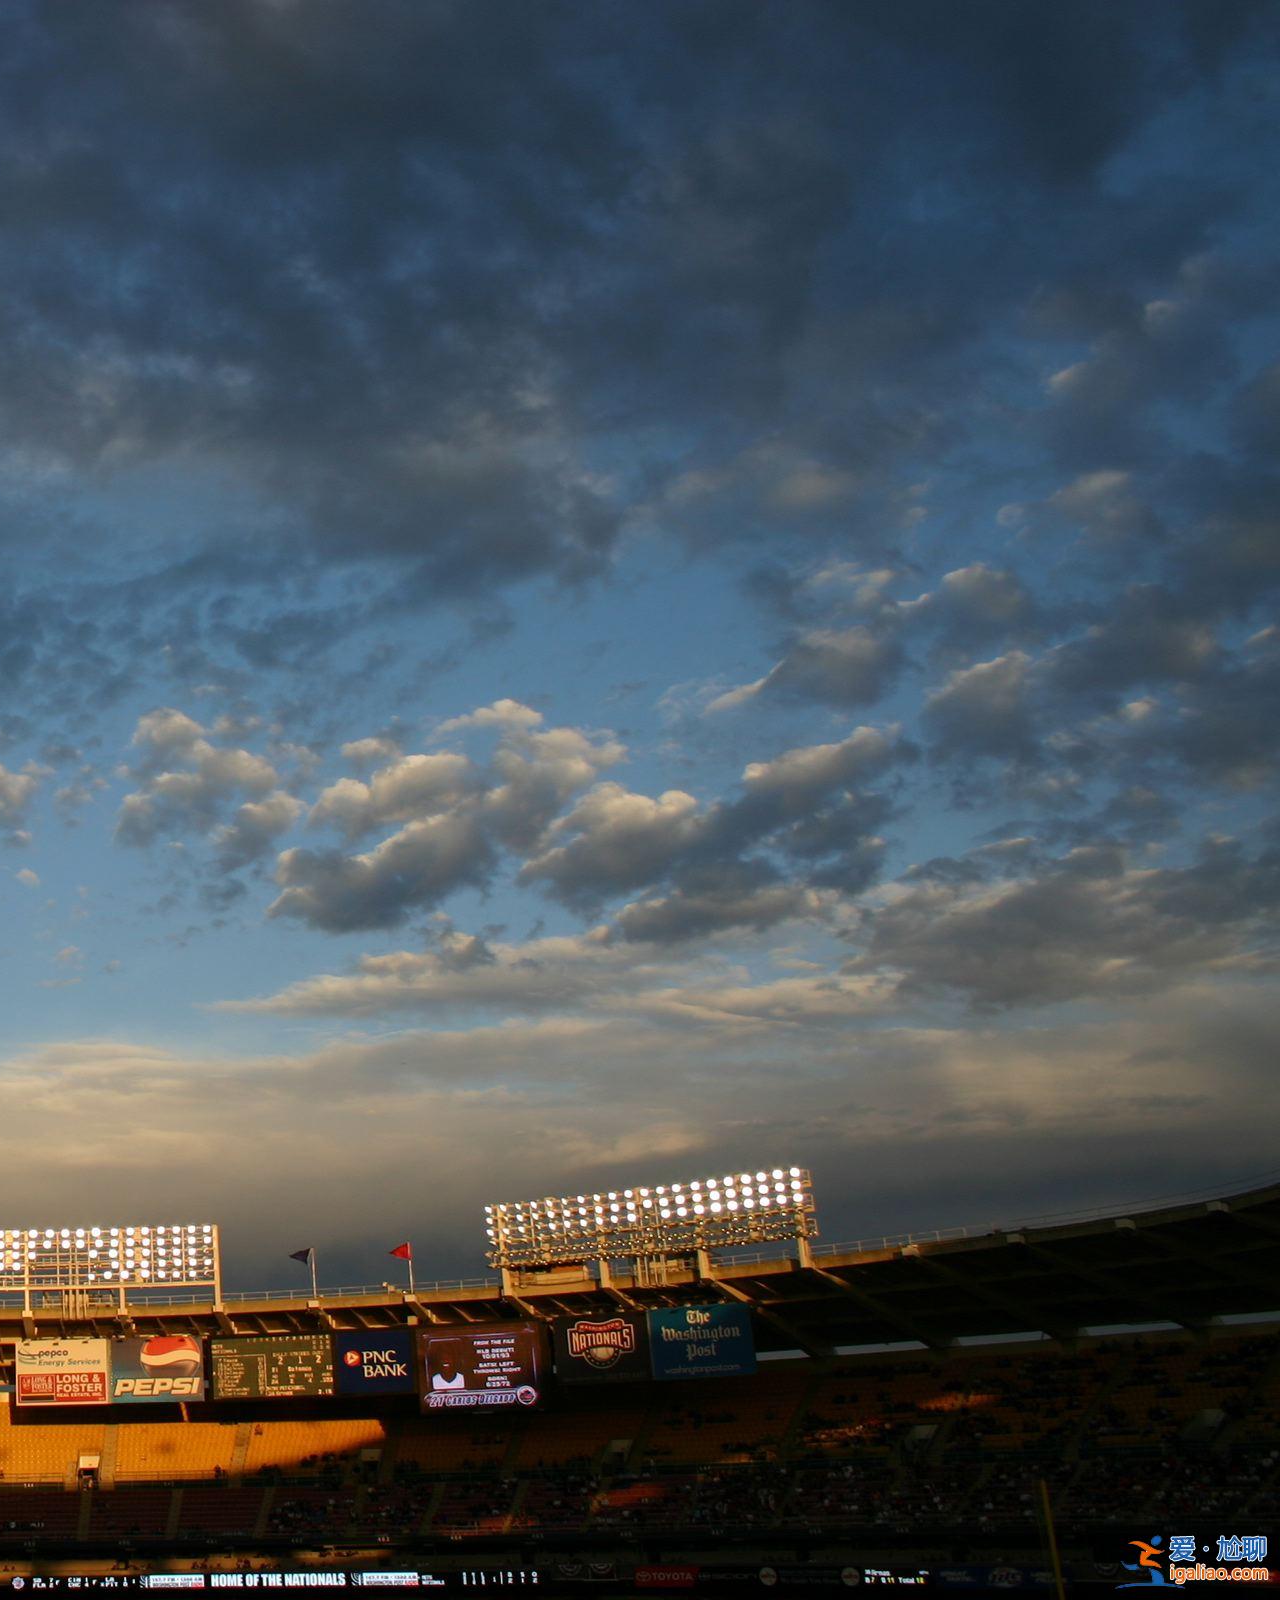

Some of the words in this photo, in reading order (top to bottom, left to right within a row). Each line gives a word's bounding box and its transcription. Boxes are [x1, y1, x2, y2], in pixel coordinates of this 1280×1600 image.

[686, 1310, 711, 1324] The
[572, 1328, 631, 1352] NATIONALS
[661, 1325, 740, 1342] Washington
[38, 1350, 68, 1358] pepco
[362, 1350, 397, 1364] PNC
[686, 1343, 716, 1360] Post
[278, 1356, 284, 1365] 2
[298, 1355, 302, 1364] 1
[315, 1354, 321, 1364] 2
[362, 1363, 408, 1377] BANK
[56, 1374, 89, 1383] LONG
[92, 1374, 100, 1382] &
[56, 1383, 103, 1393] FOSTER
[113, 1377, 201, 1397] PEPSI
[210, 1574, 243, 1587] HOME
[245, 1574, 259, 1586] OF
[261, 1573, 283, 1586] THE
[284, 1573, 346, 1586] NATIONALS
[652, 1572, 693, 1580] TOYOTA
